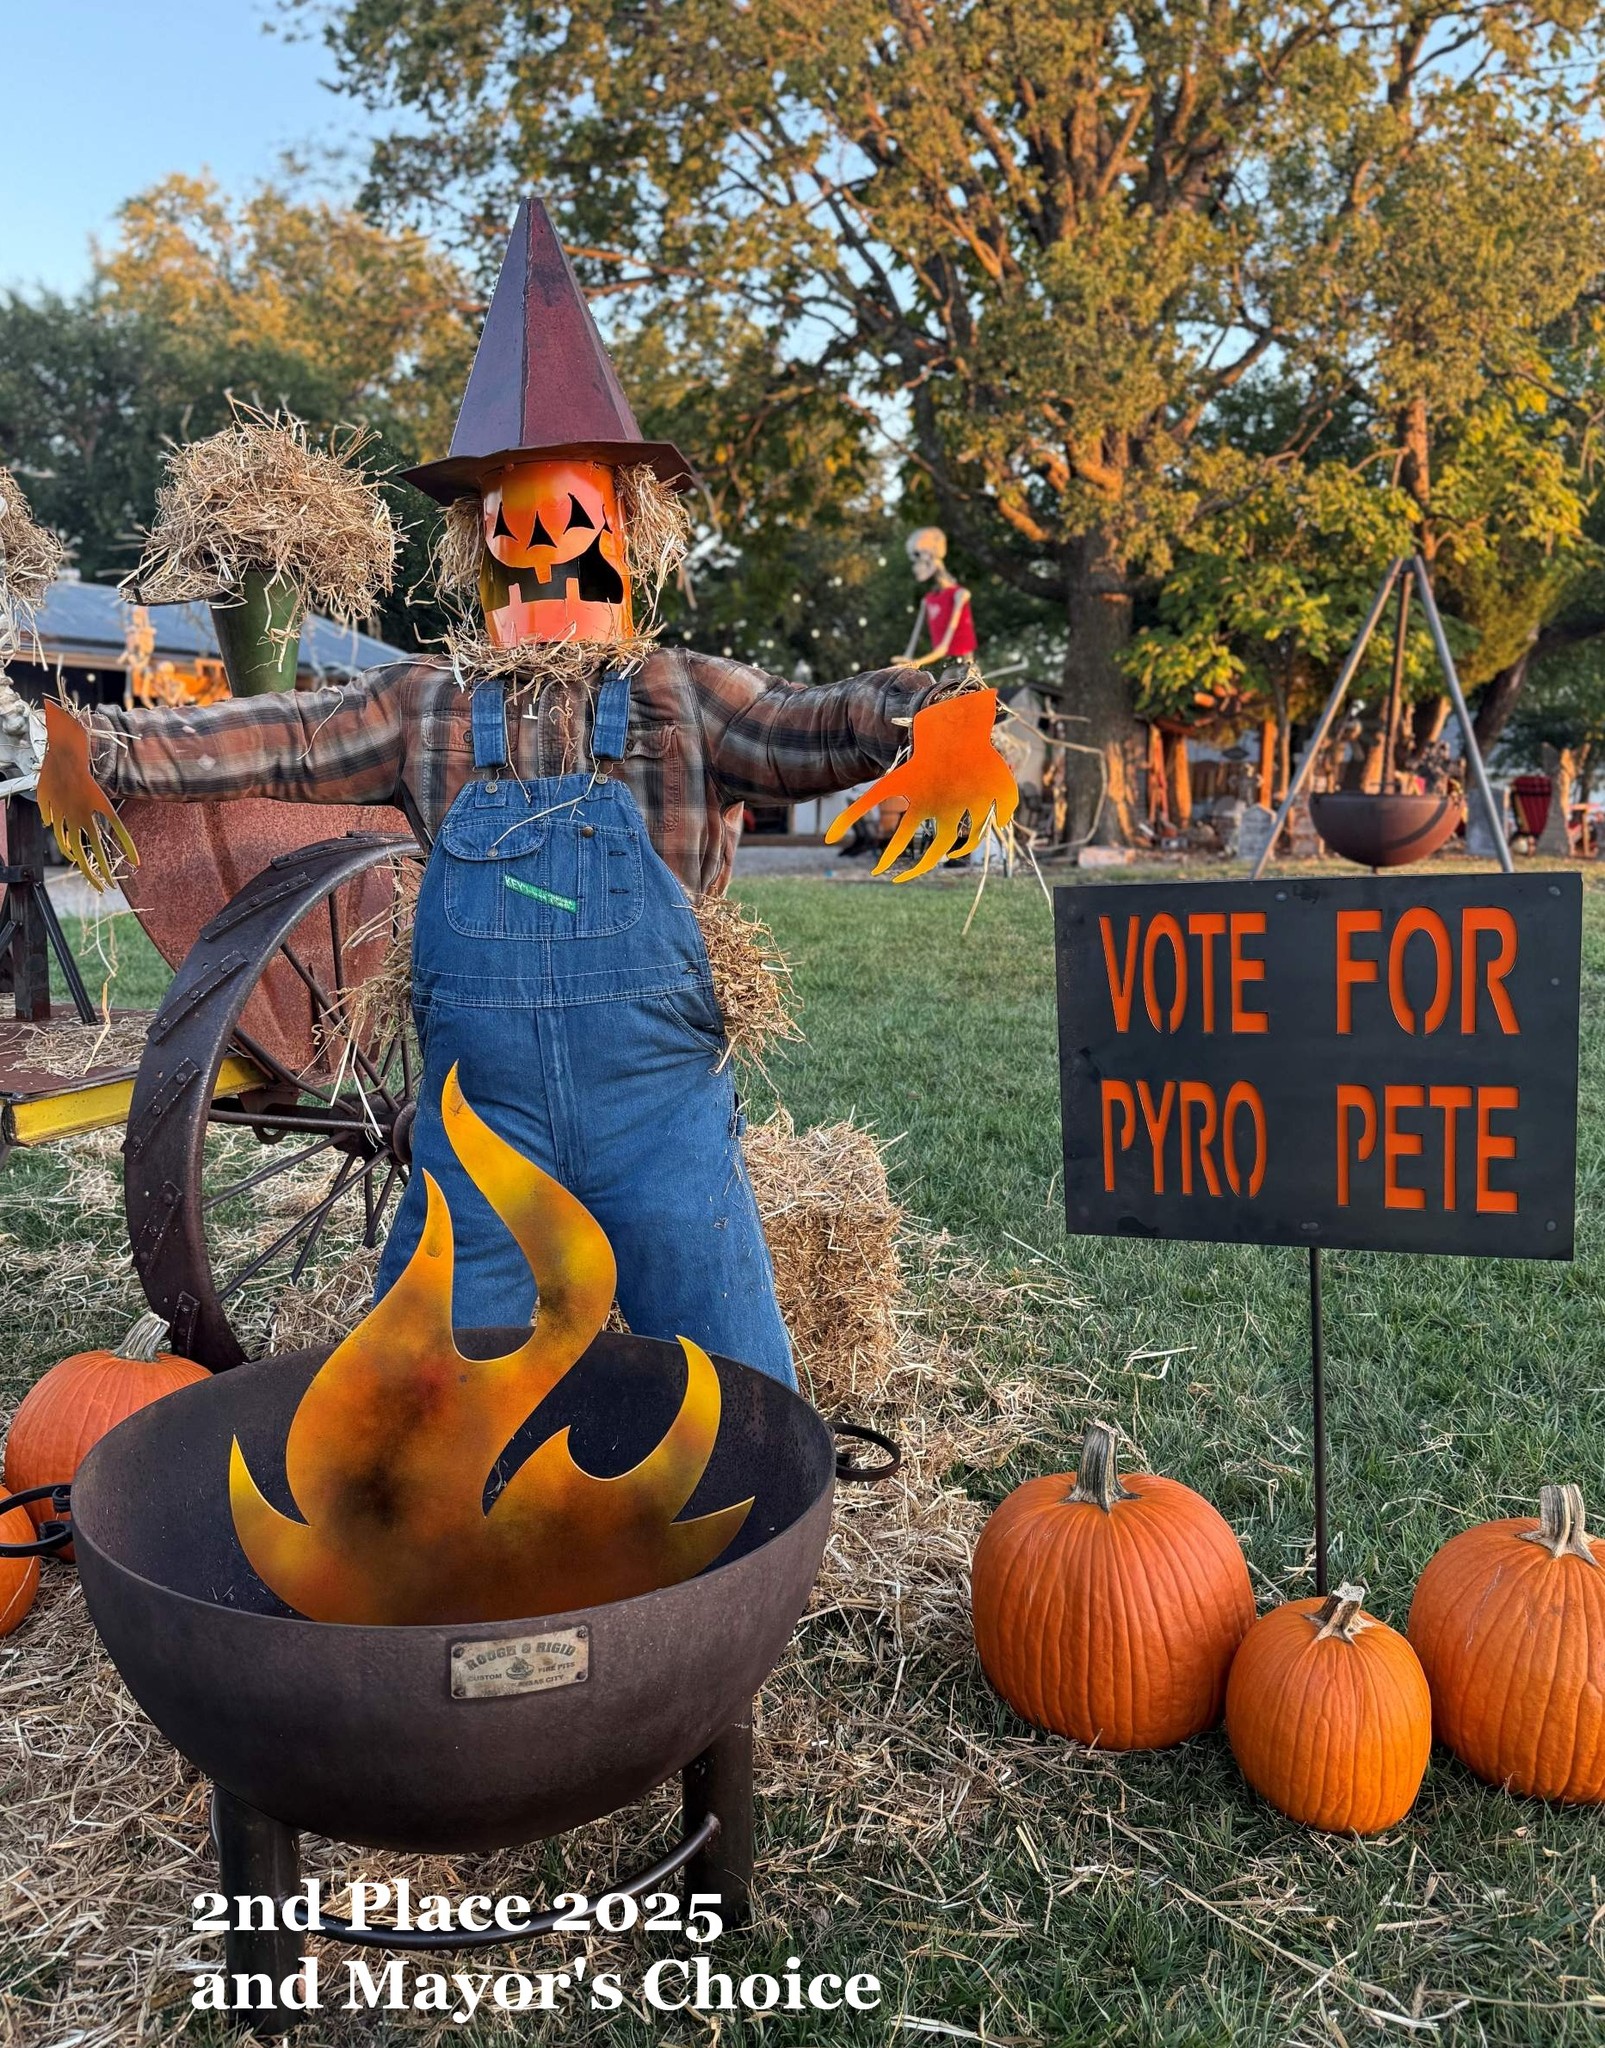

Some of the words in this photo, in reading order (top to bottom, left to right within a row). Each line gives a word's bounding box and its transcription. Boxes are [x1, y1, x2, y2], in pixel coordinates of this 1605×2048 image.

[1100, 912, 1269, 1034] VOTE
[1336, 907, 1519, 1035] FOR
[1101, 1080, 1267, 1198] PYRO
[1337, 1084, 1519, 1214] PETE
[535, 1641, 577, 1657] RIGID
[545, 1674, 564, 1683] CITY
